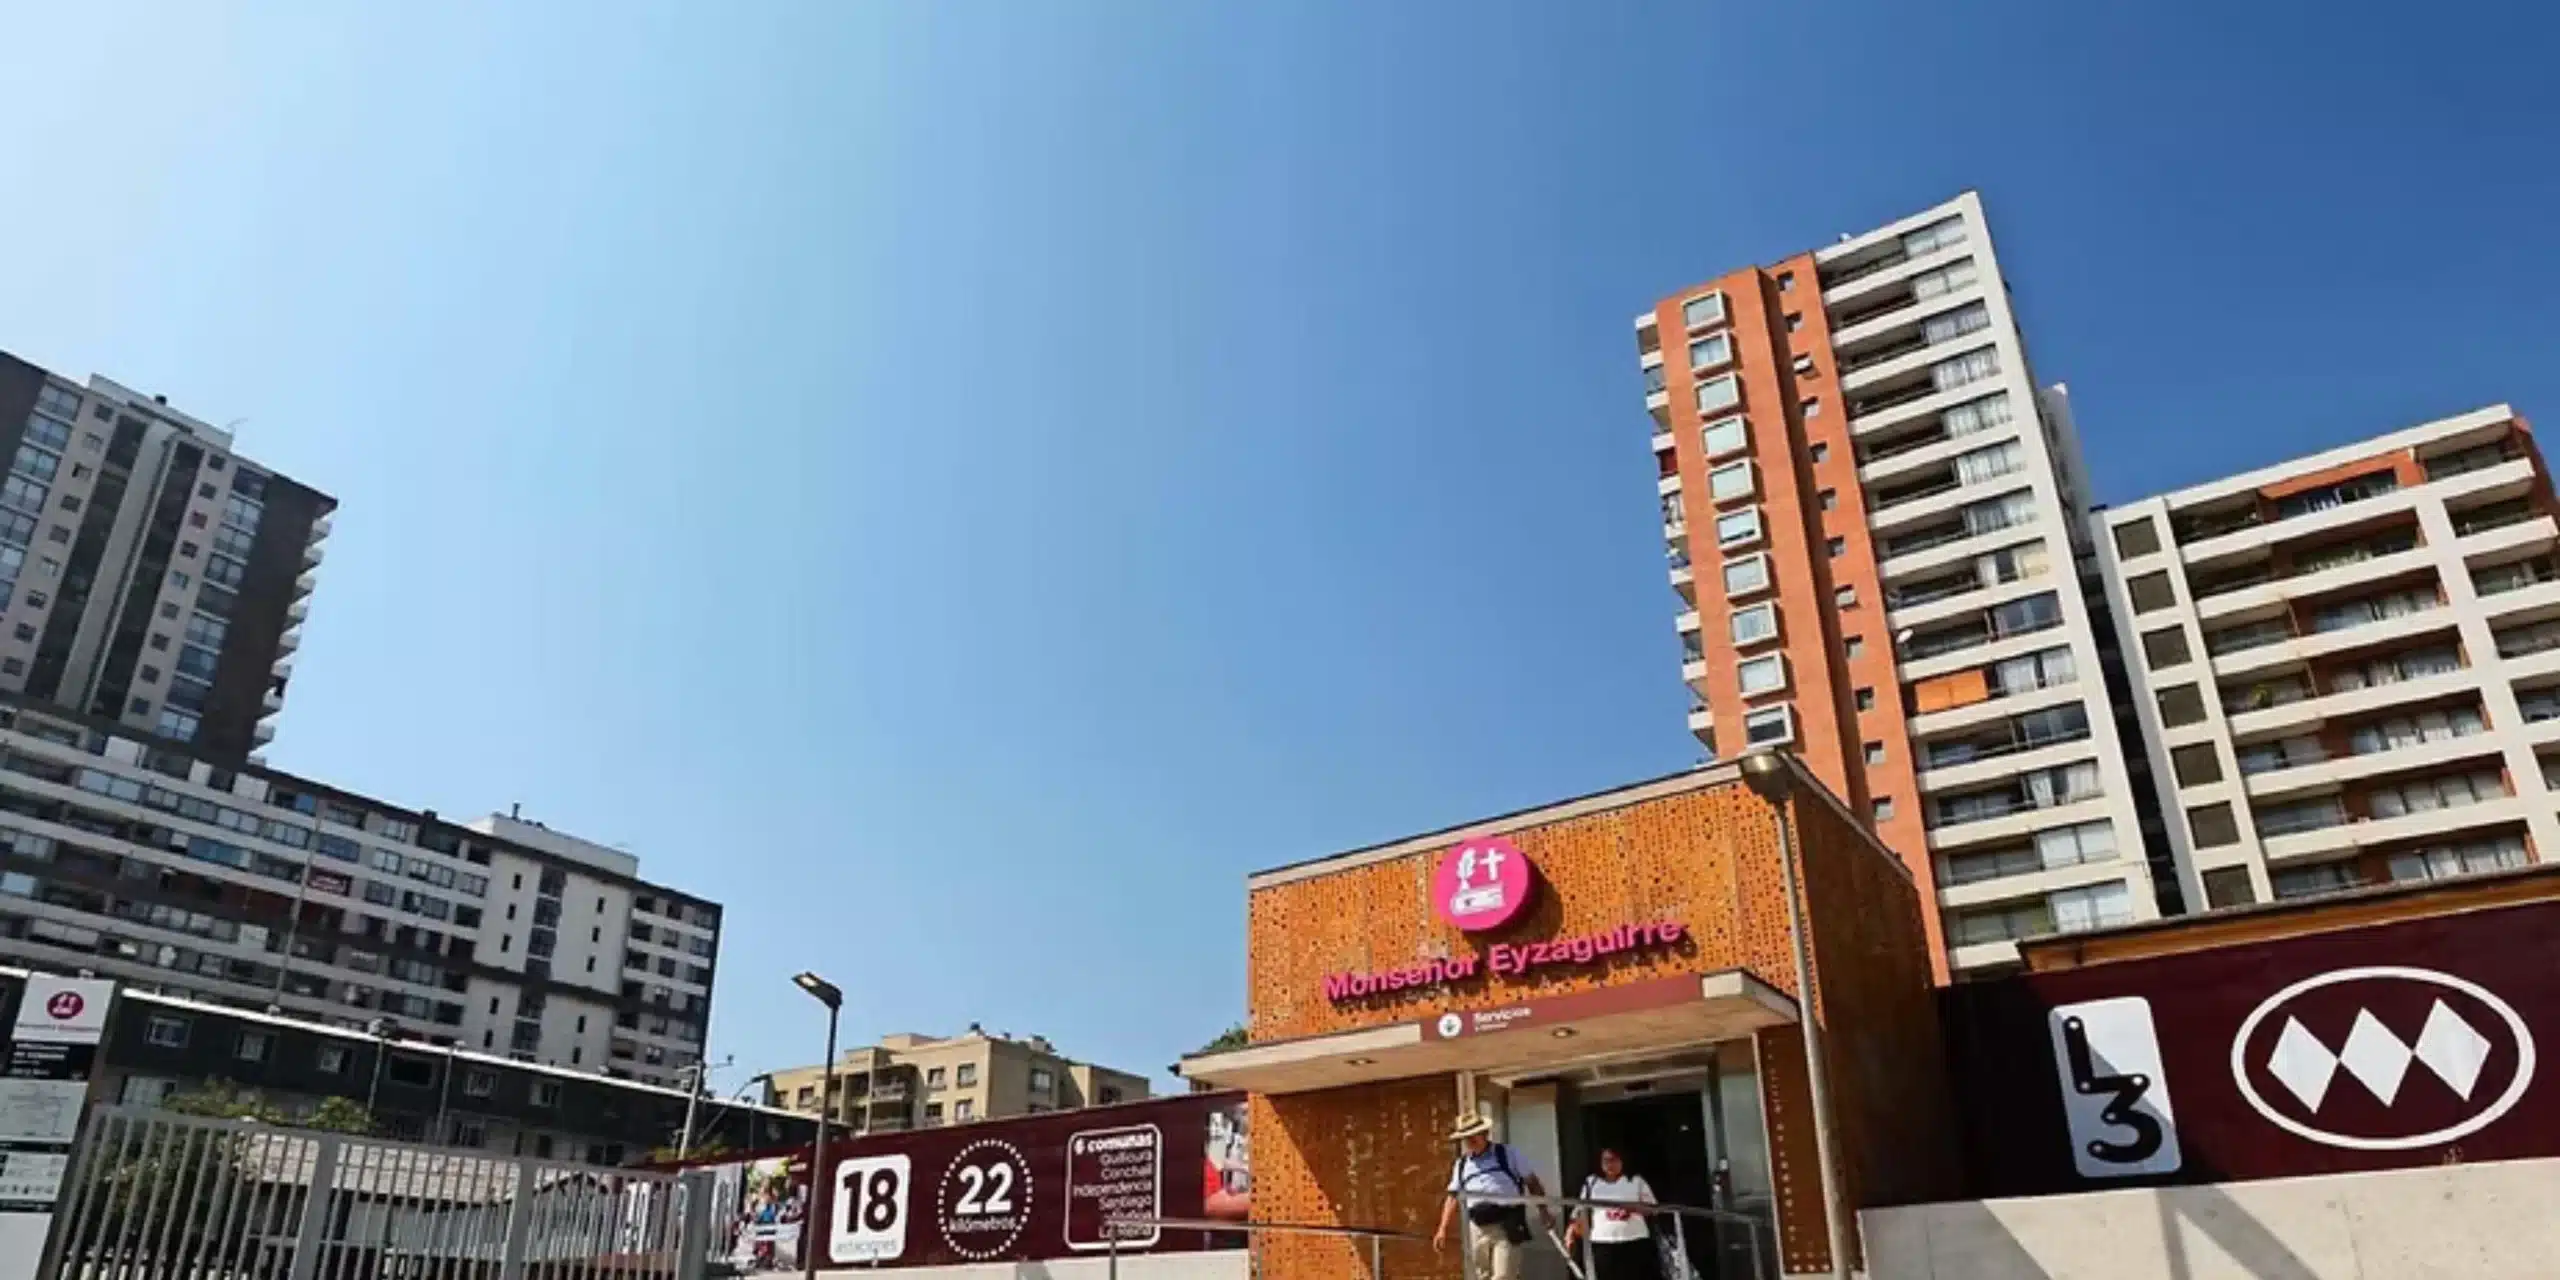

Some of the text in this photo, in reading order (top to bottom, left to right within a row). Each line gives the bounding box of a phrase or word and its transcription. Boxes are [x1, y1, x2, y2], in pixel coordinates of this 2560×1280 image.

[1489, 920, 1682, 974] Eyzaguirre
[1473, 1007, 1533, 1024] Servicios
[1087, 1133, 1153, 1153] comunas
[843, 1167, 899, 1235] 18
[955, 1162, 1014, 1215] 22
